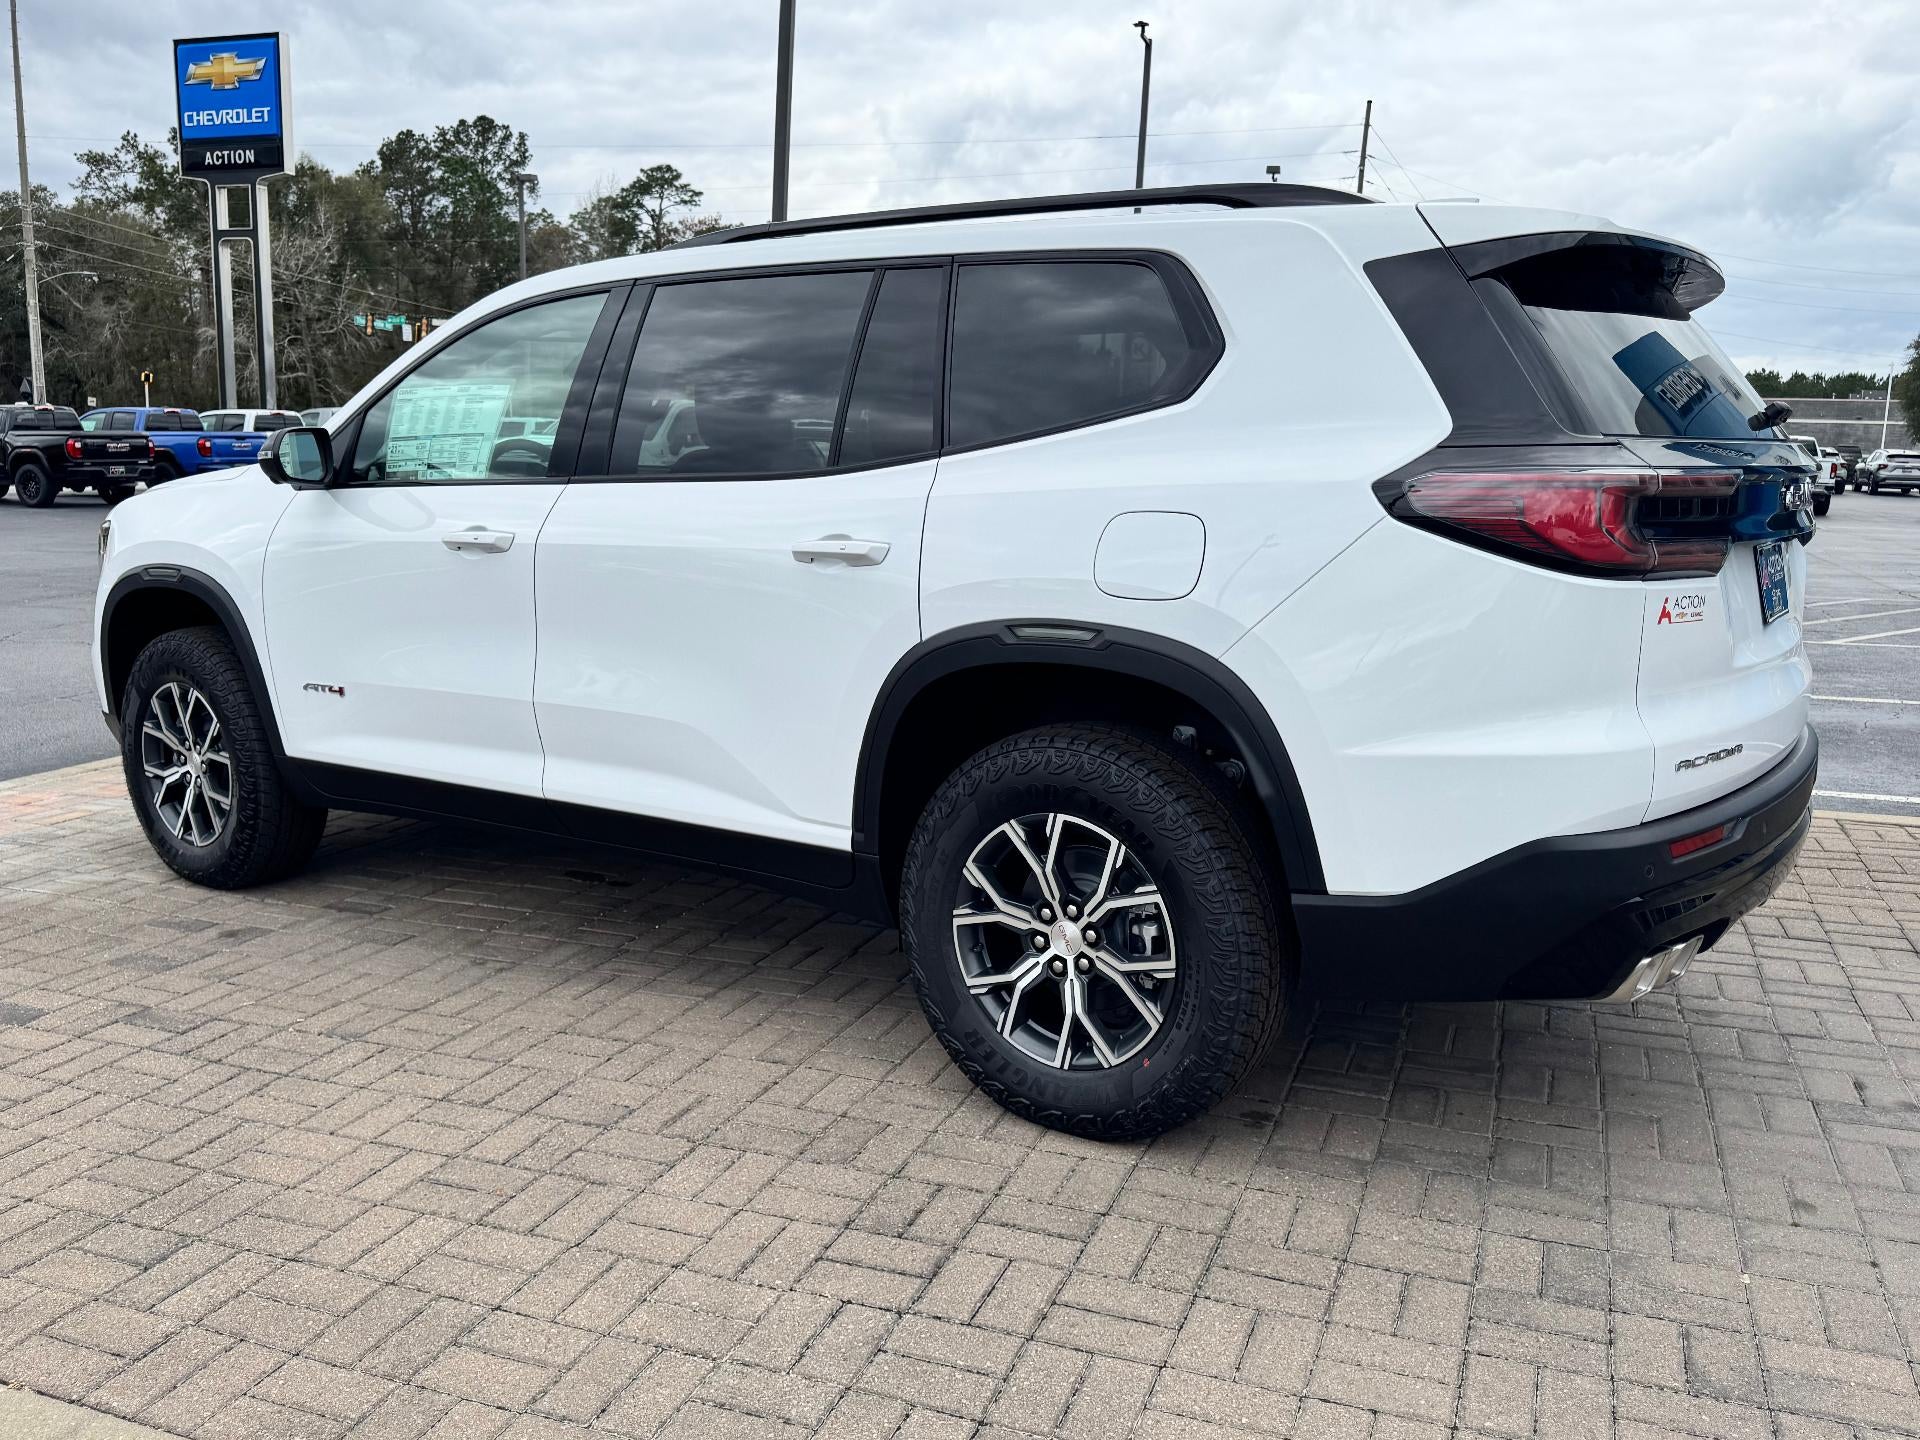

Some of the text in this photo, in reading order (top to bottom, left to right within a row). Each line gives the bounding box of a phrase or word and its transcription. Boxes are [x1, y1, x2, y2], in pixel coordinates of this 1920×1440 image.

[184, 107, 271, 127] CHEVROLET
[204, 149, 255, 166] ACTION
[1673, 595, 1706, 610] ACTION
[303, 683, 345, 697] AT4
[1675, 744, 1743, 772] ACADIA
[1058, 924, 1073, 954] GMC
